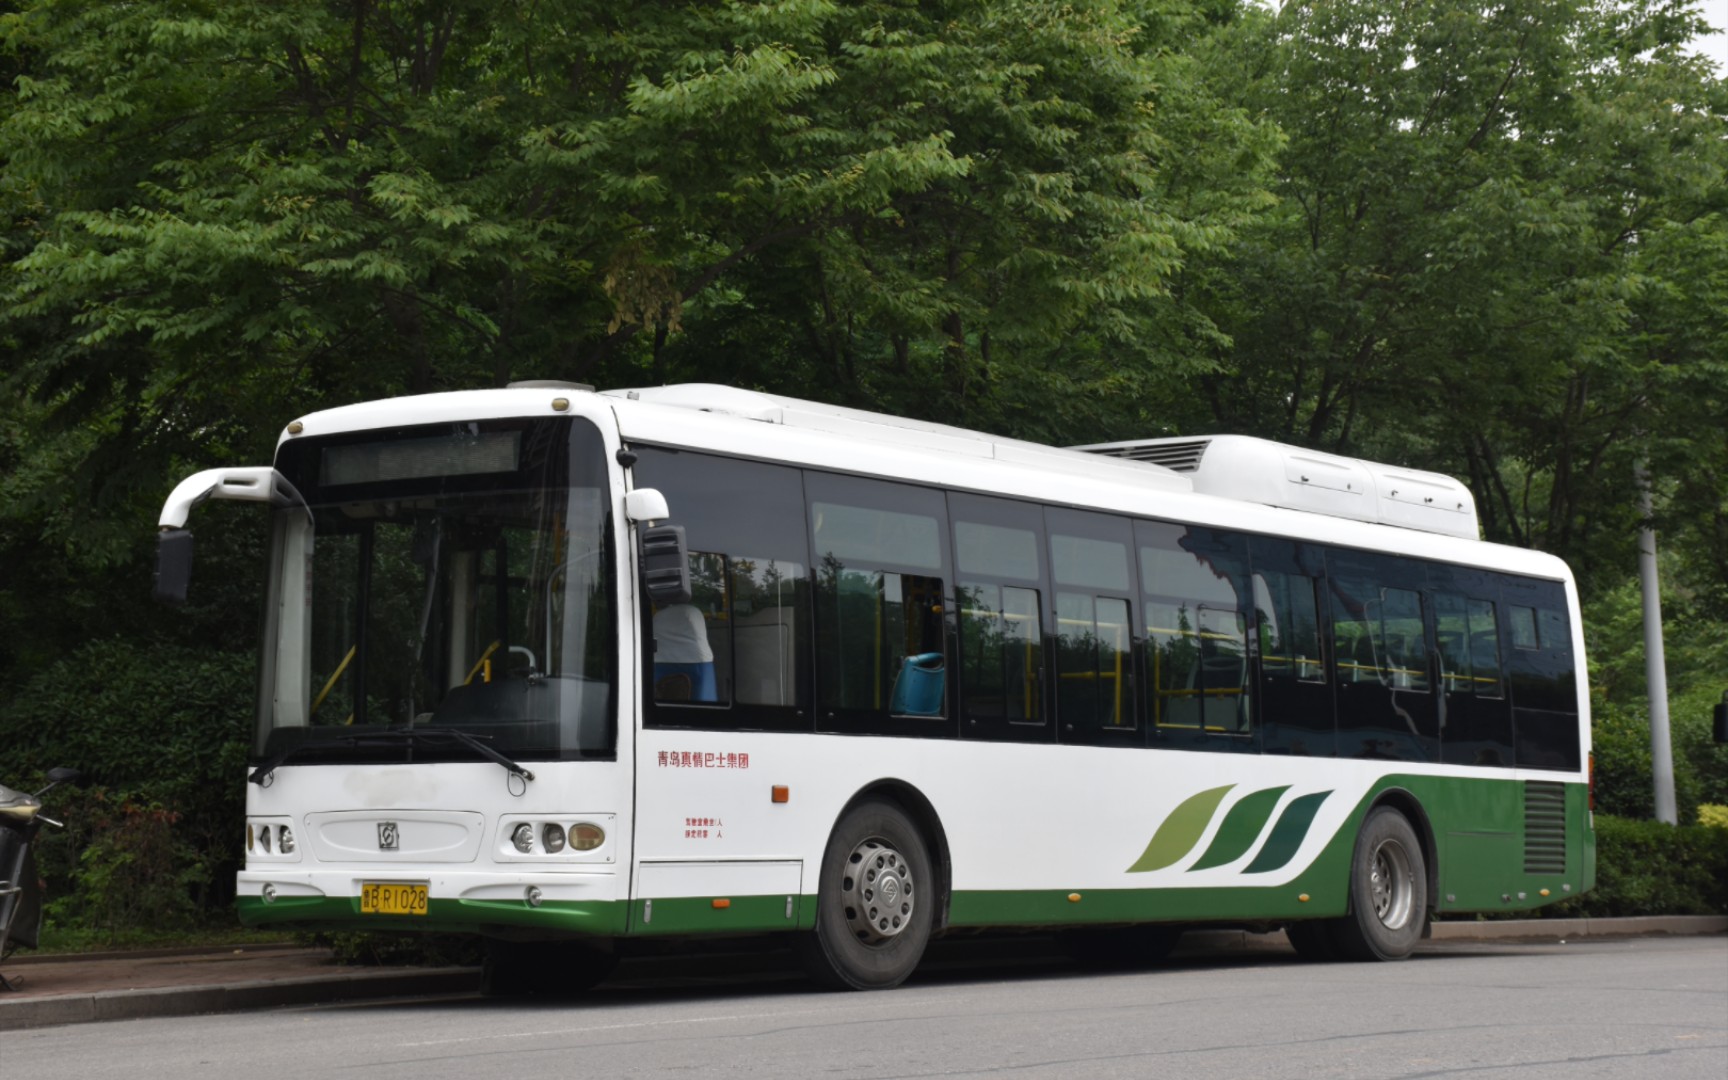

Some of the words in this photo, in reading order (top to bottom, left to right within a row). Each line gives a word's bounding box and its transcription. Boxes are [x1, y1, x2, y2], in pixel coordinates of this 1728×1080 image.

[657, 750, 749, 769] 青岛真情巴士集团
